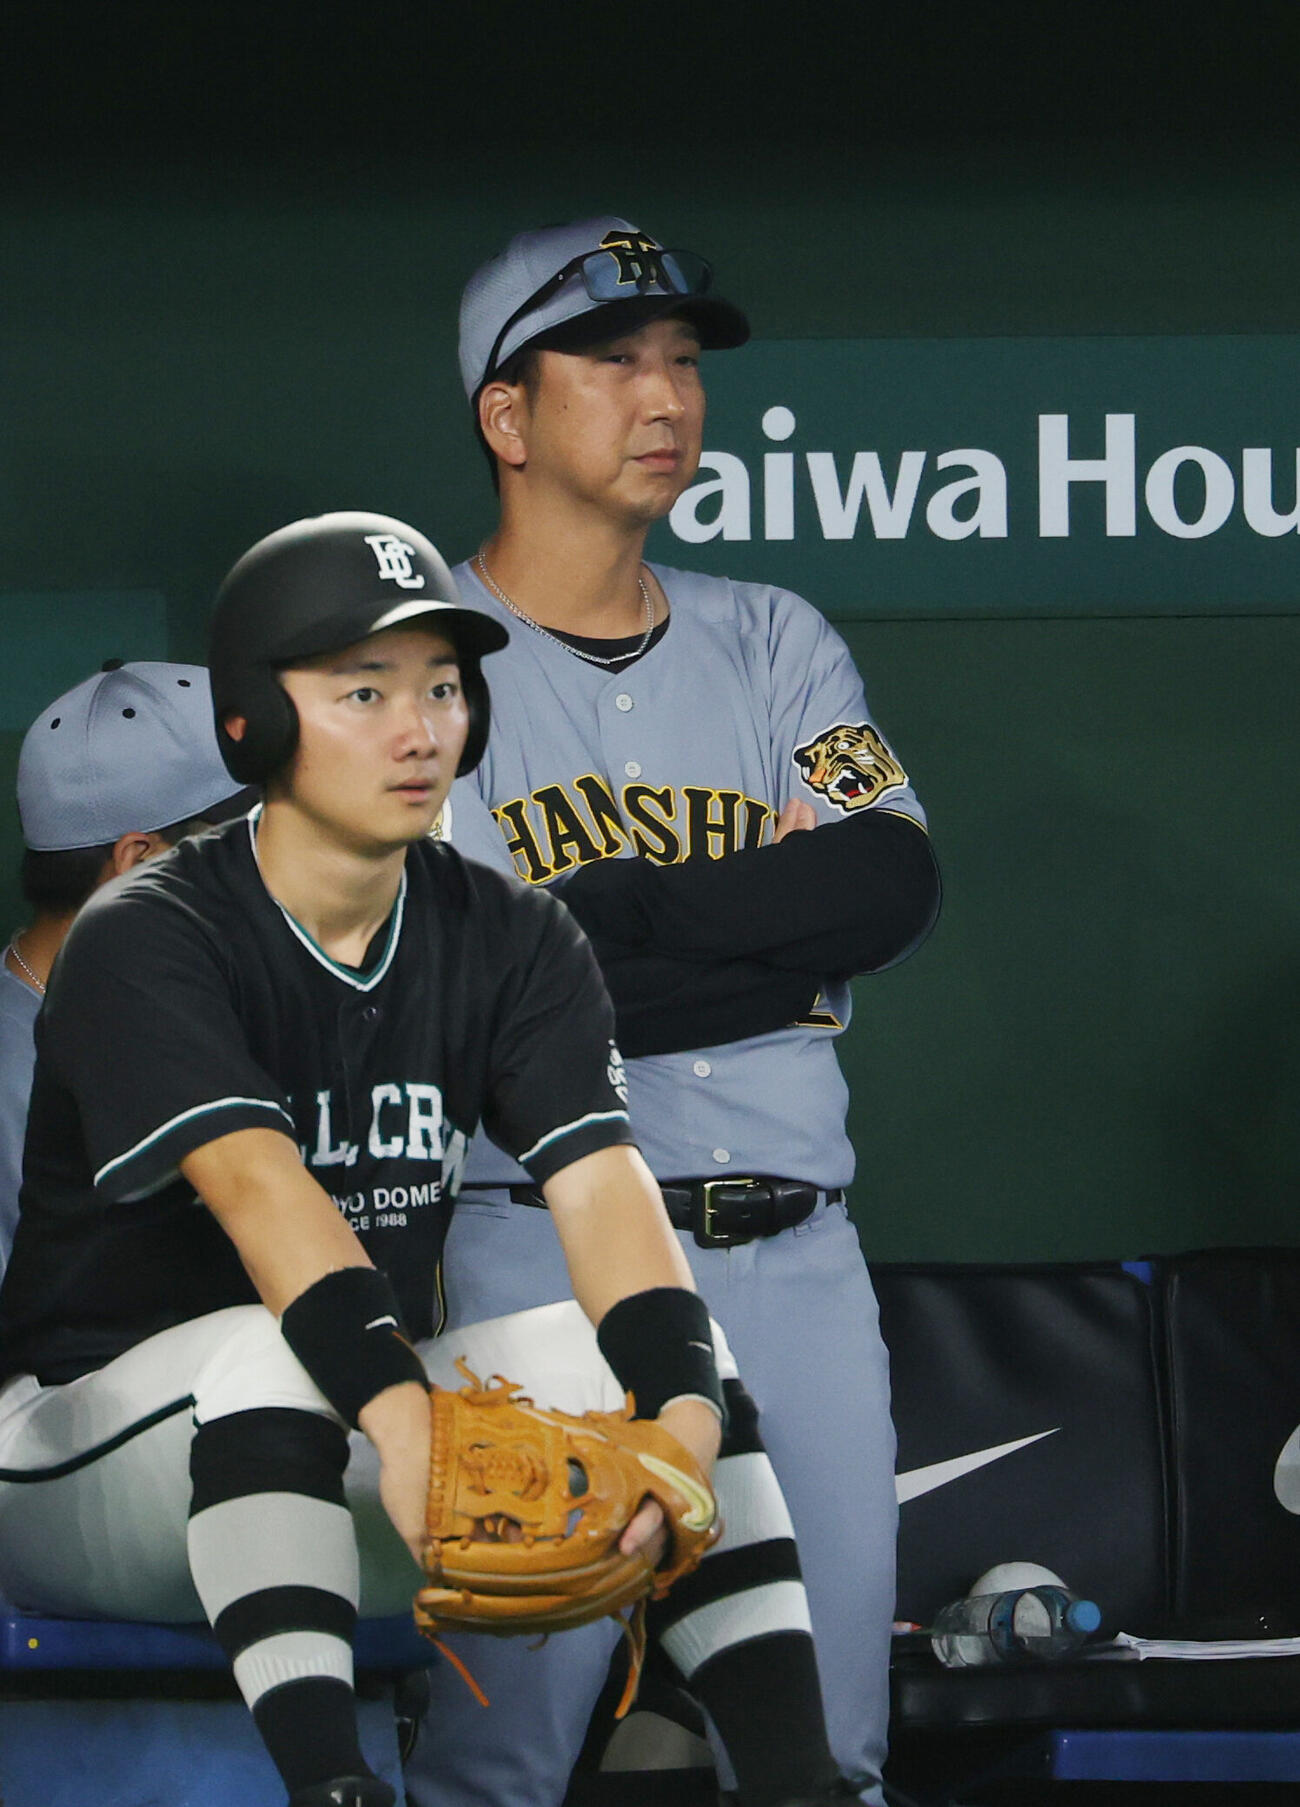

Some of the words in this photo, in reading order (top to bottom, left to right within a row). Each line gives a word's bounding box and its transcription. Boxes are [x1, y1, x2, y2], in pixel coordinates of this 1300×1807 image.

[668, 406, 1008, 543] aiwa
[491, 773, 779, 885] HANSHI
[373, 1180, 442, 1210] DOME
[376, 1213, 407, 1228] 1988
